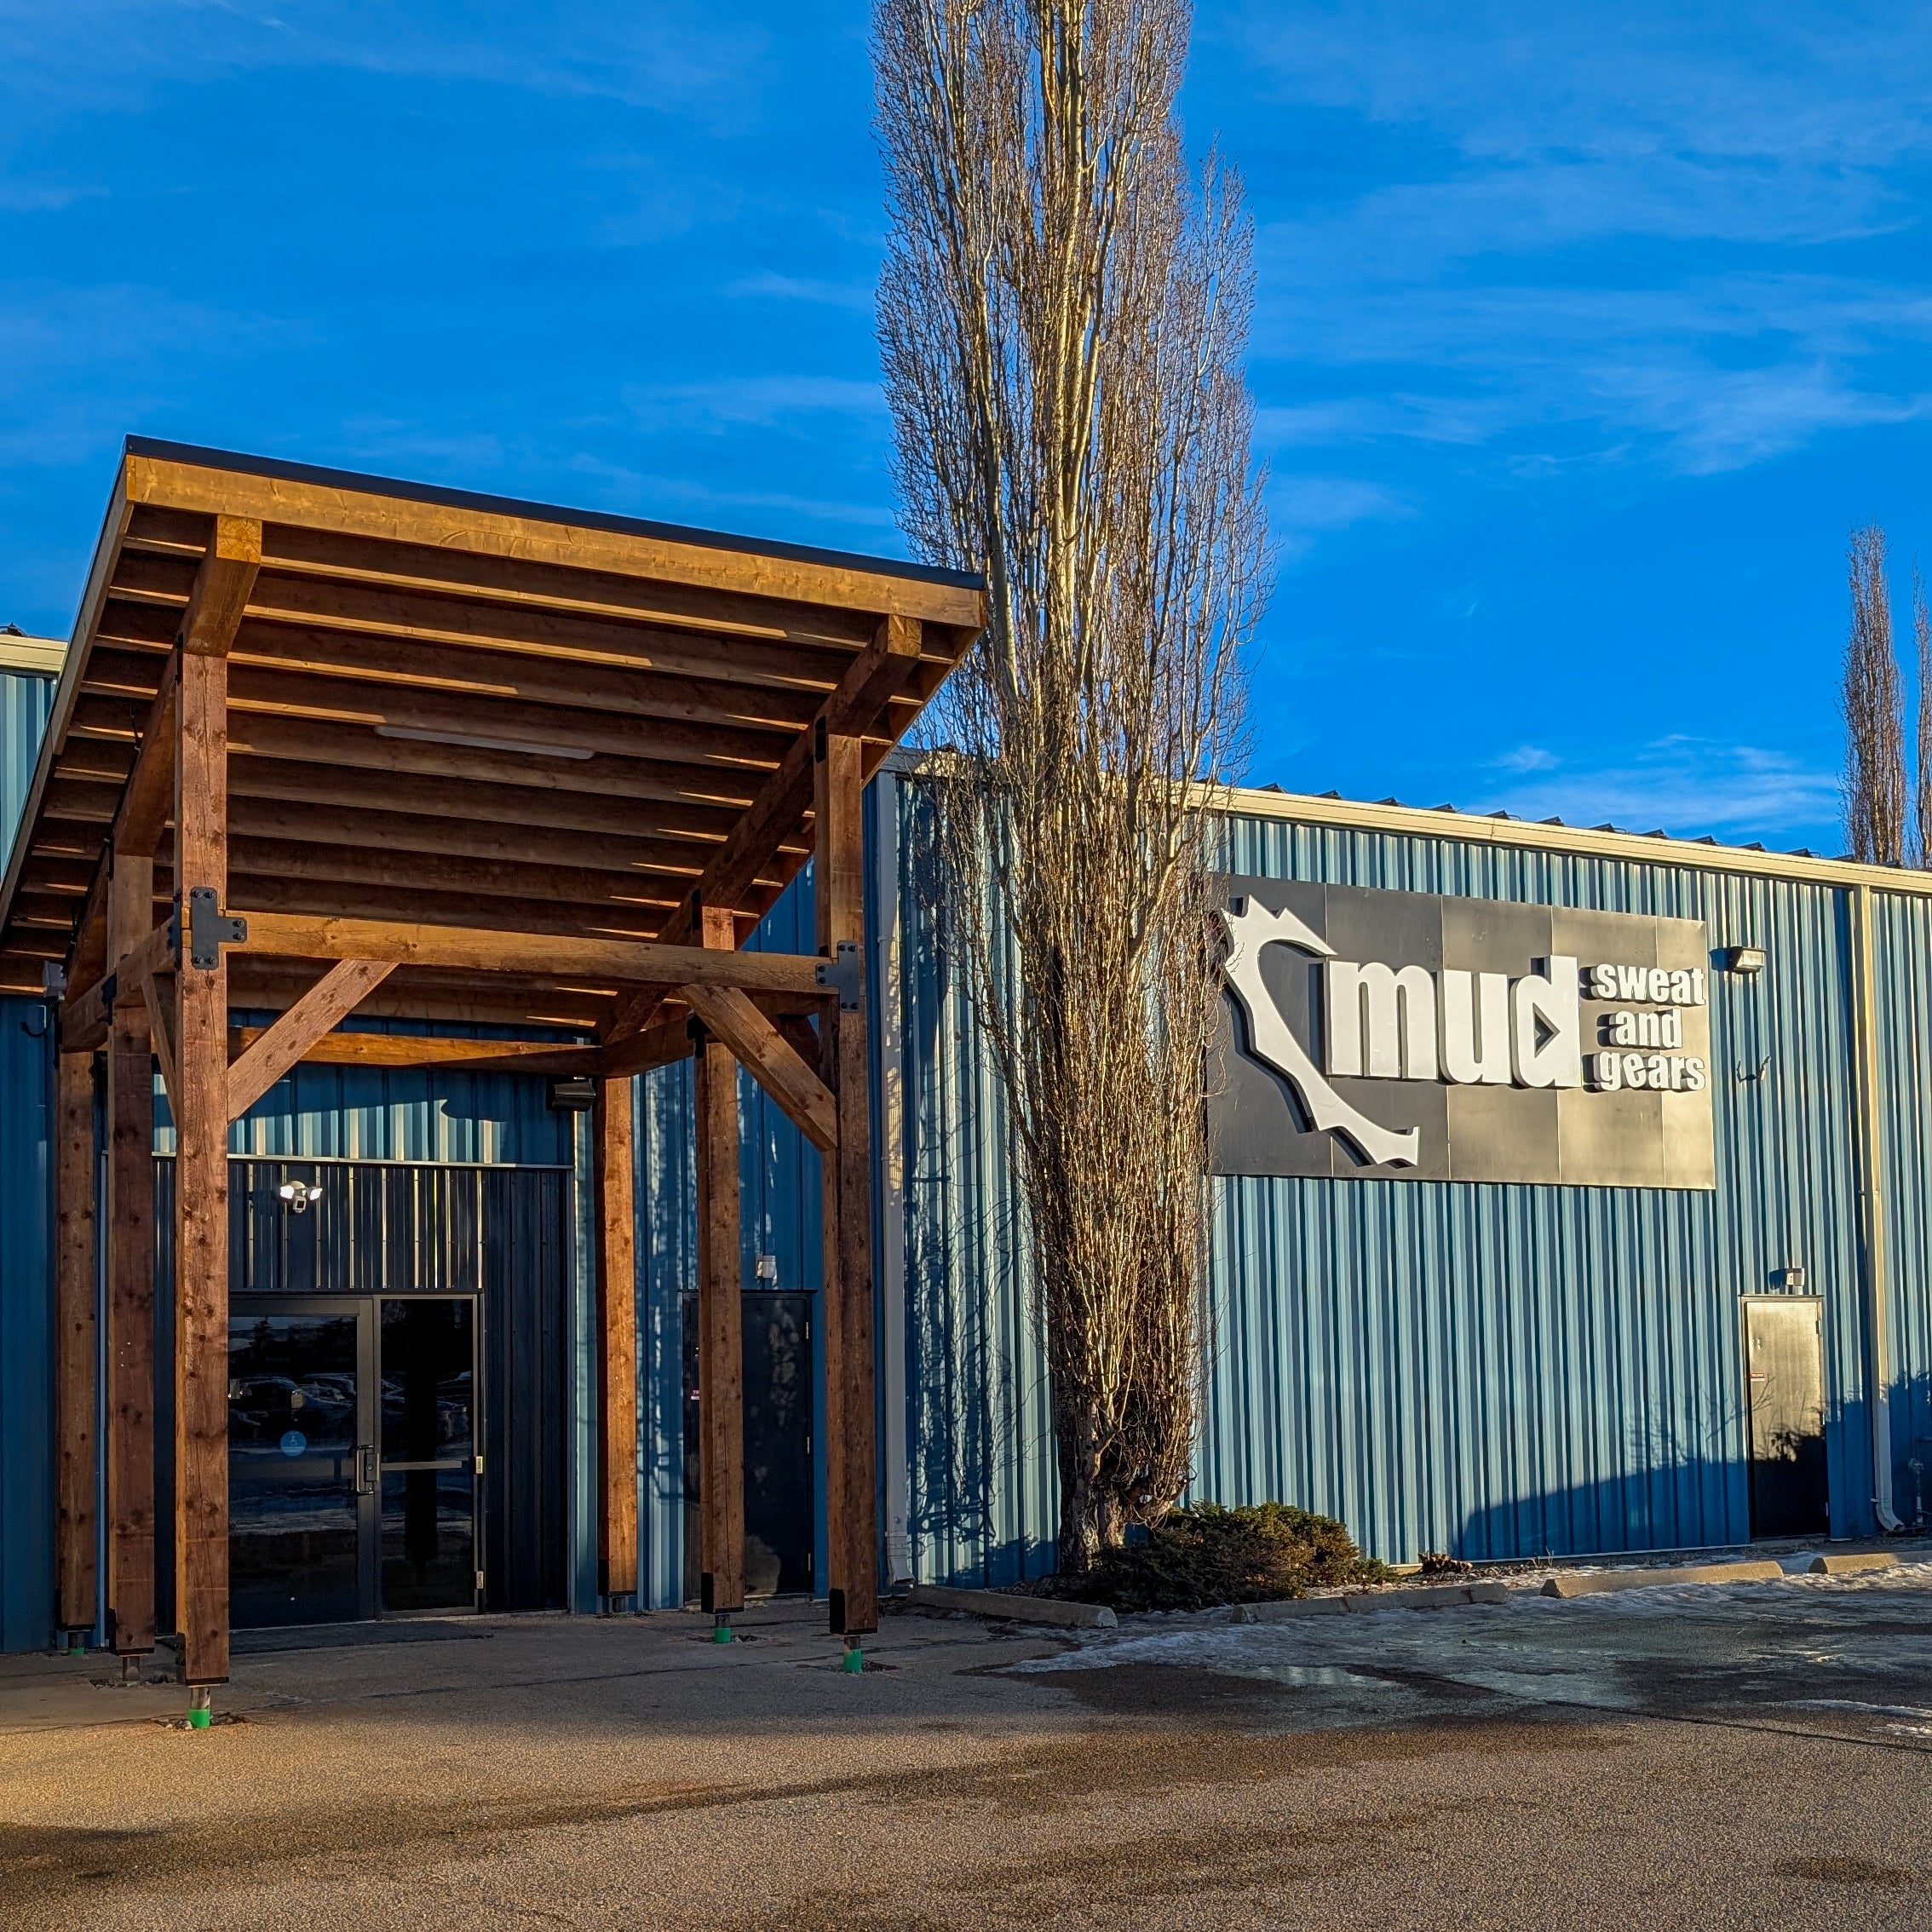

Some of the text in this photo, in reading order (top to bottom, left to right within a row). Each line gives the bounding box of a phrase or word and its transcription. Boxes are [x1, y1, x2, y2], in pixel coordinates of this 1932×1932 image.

[1596, 963, 1705, 1005] sweat
[1327, 955, 1582, 1088] mud
[1615, 1009, 1682, 1049] and
[1599, 1051, 1705, 1091] gears
